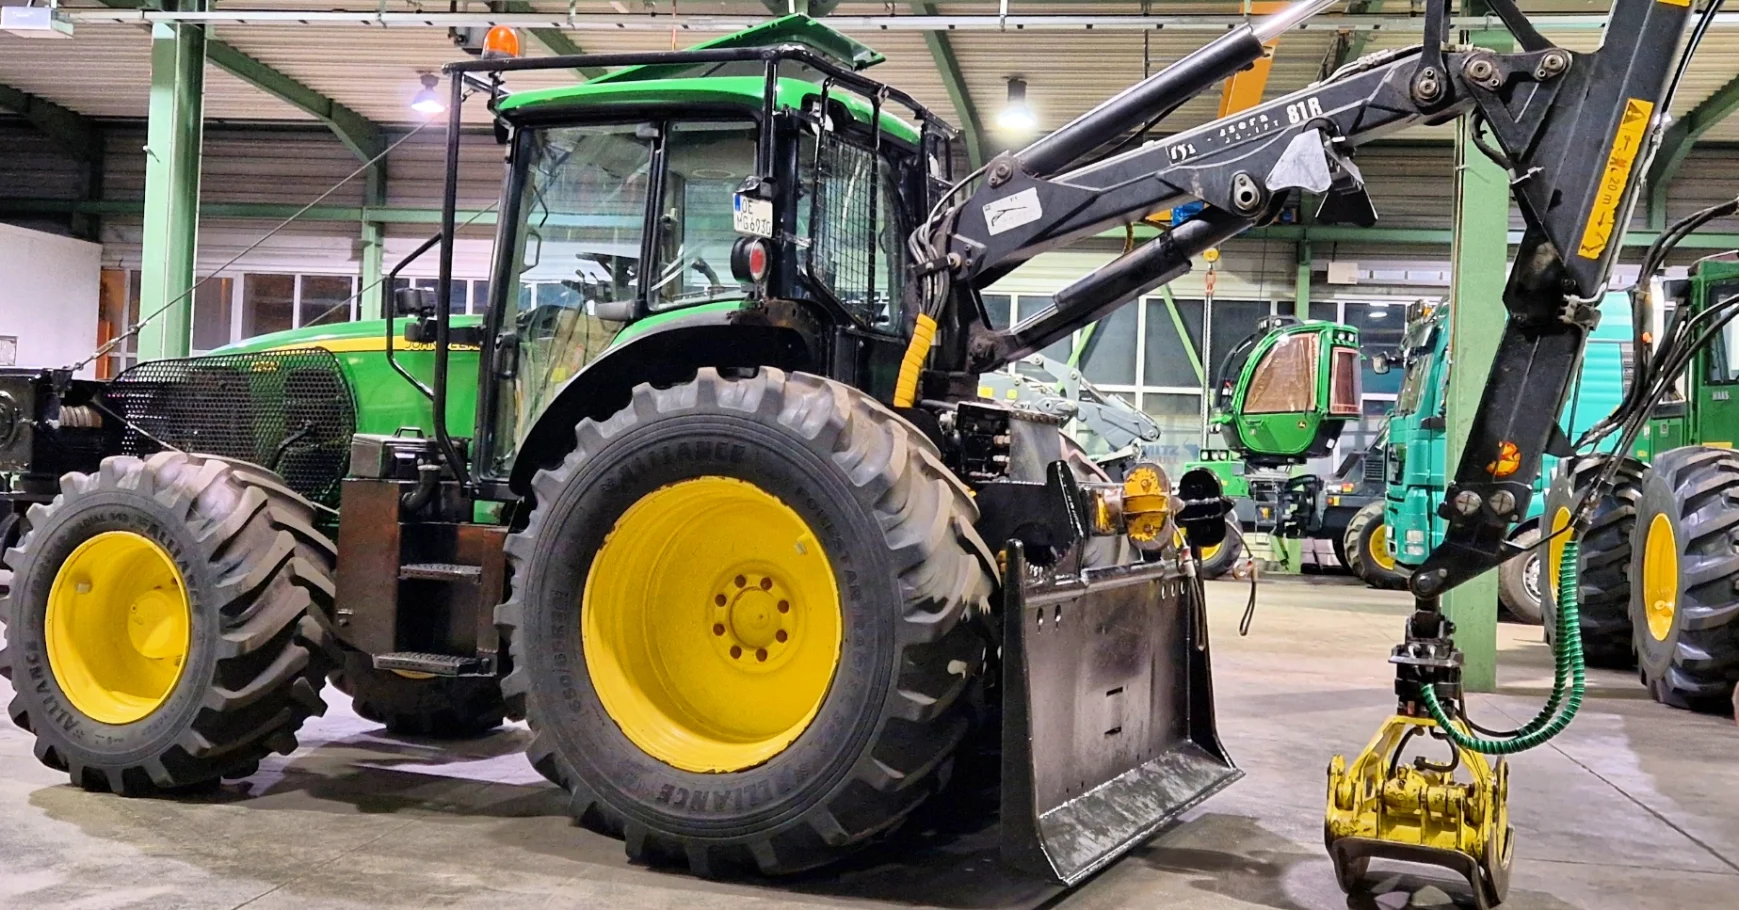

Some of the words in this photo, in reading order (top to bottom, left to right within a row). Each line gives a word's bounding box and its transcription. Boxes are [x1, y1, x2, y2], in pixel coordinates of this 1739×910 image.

[1286, 97, 1323, 124] 81R
[1607, 177, 1620, 191] 20
[1602, 193, 1612, 205] m
[742, 199, 754, 214] OE
